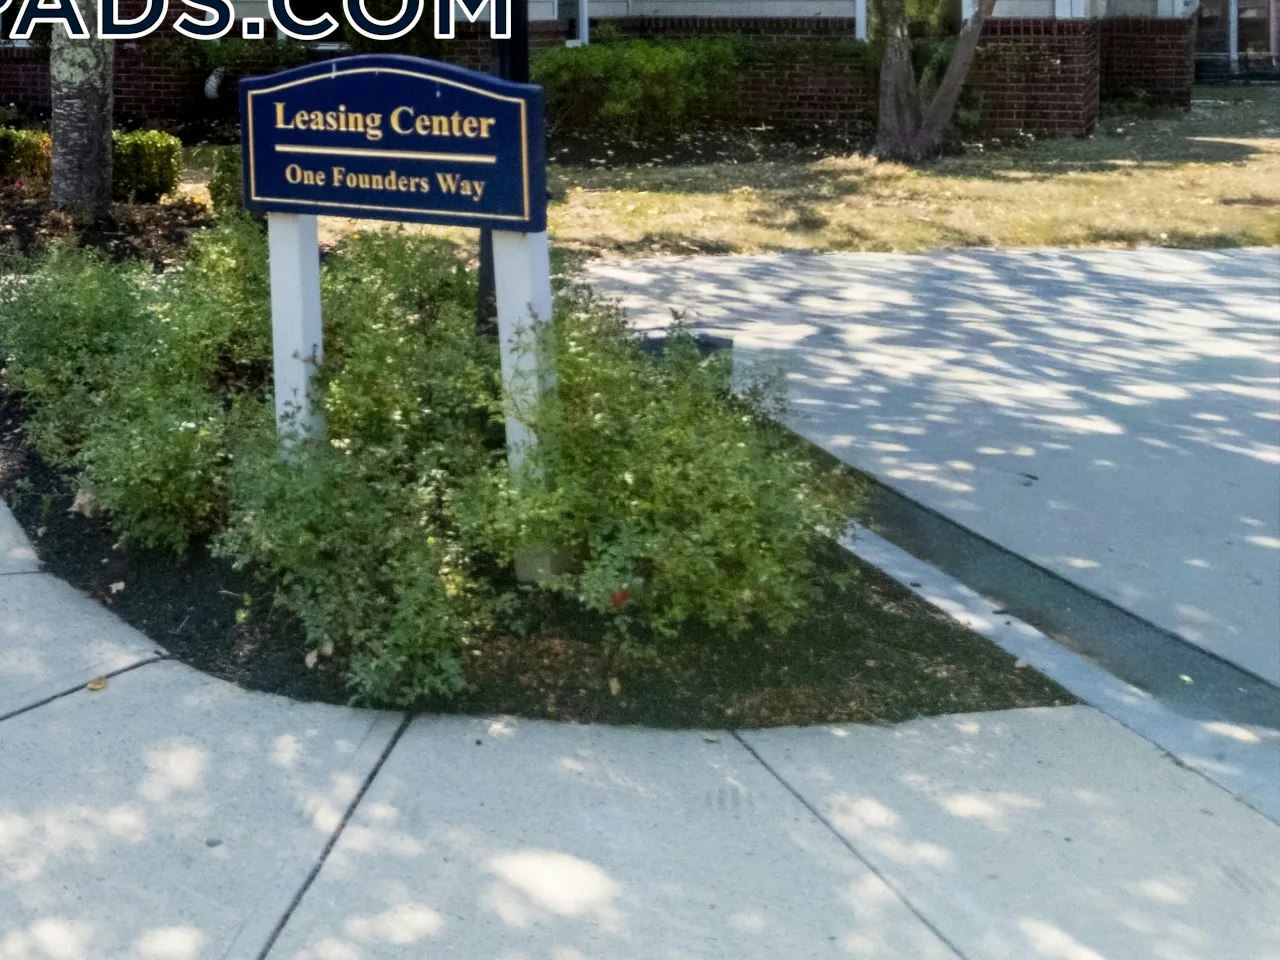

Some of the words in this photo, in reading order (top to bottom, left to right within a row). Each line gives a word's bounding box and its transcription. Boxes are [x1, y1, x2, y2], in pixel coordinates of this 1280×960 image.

[274, 102, 383, 140] Leasing
[390, 105, 496, 138] Center
[285, 164, 326, 186] One
[331, 166, 430, 193] Founders
[436, 172, 486, 201] Way
